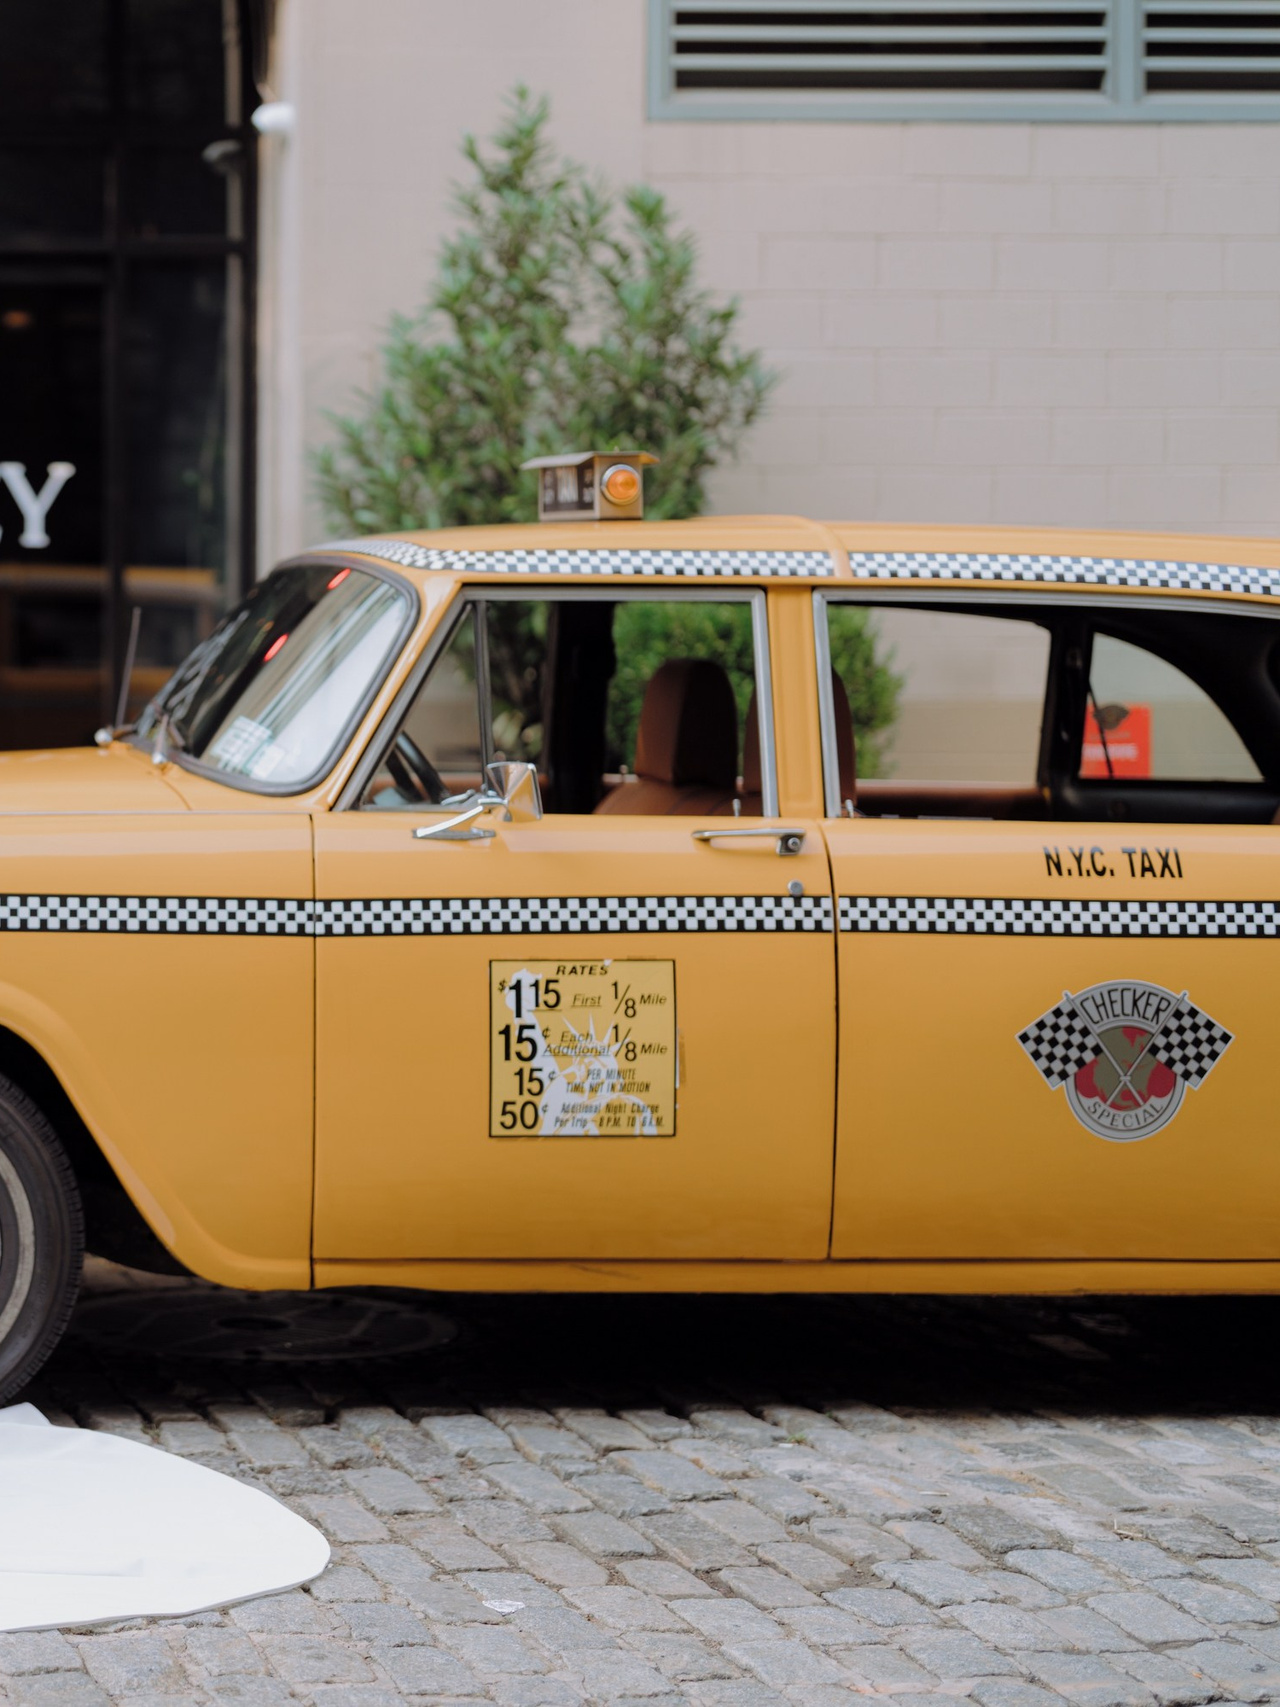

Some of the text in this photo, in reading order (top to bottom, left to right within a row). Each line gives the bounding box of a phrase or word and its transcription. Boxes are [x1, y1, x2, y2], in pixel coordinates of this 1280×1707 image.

[1043, 846, 1183, 878] N.Y.C. TAXI
[556, 965, 609, 976] RATES
[571, 994, 602, 1007] First
[639, 994, 667, 1005] Mile
[1079, 988, 1172, 1025] CHECKER
[560, 1031, 593, 1043] Each
[543, 1043, 611, 1056] Additional
[640, 1044, 667, 1055] Mile
[587, 1068, 601, 1080] PER
[606, 1068, 636, 1080] MINUTE
[589, 1082, 604, 1093] NOT
[619, 1082, 651, 1093] MOTION
[1087, 1101, 1164, 1129] SPECIAL
